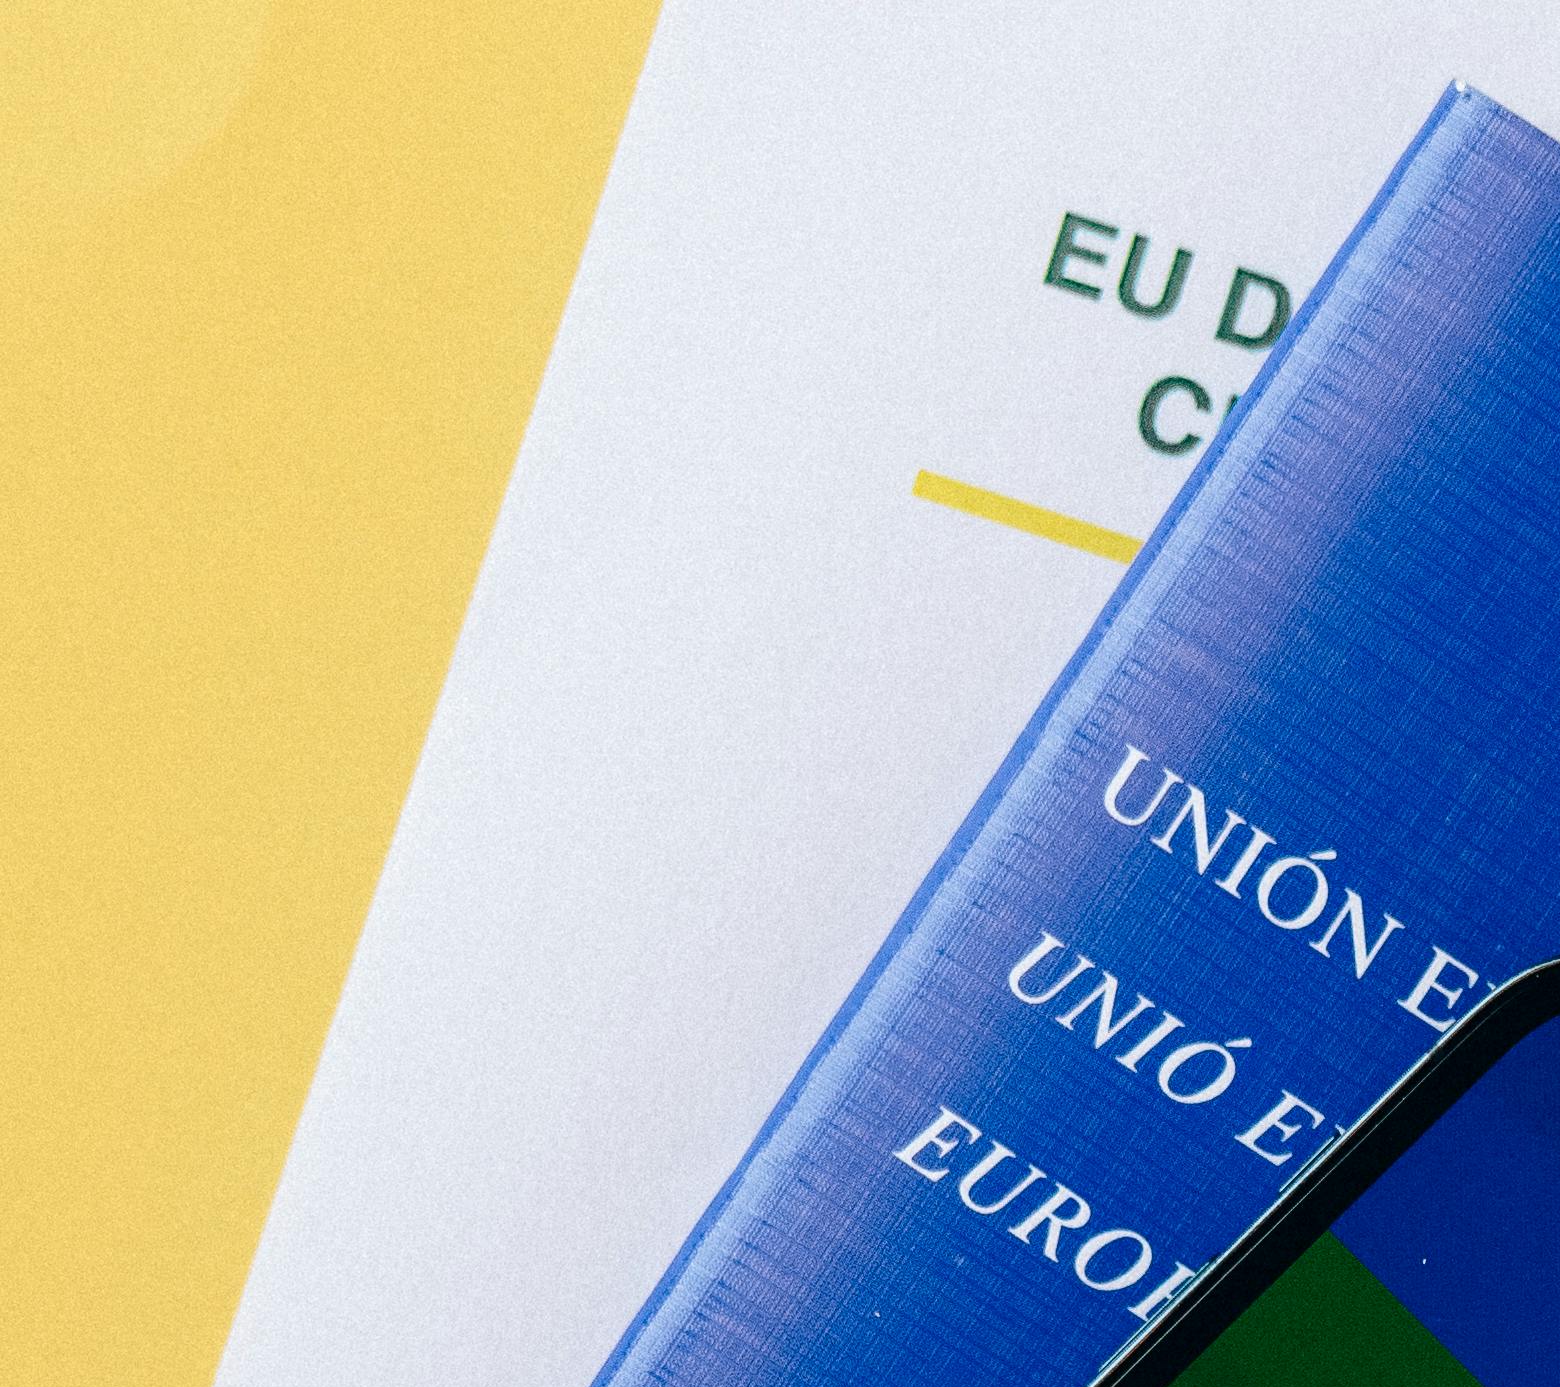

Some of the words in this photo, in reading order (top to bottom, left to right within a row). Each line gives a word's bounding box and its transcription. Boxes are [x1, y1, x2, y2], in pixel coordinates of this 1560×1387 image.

[1043, 211, 1193, 318] EU
[1102, 742, 1403, 978] UNIÓN
[1399, 946, 1497, 1036] E
[1007, 930, 1252, 1104] UNIÓ
[1234, 1092, 1338, 1172] E
